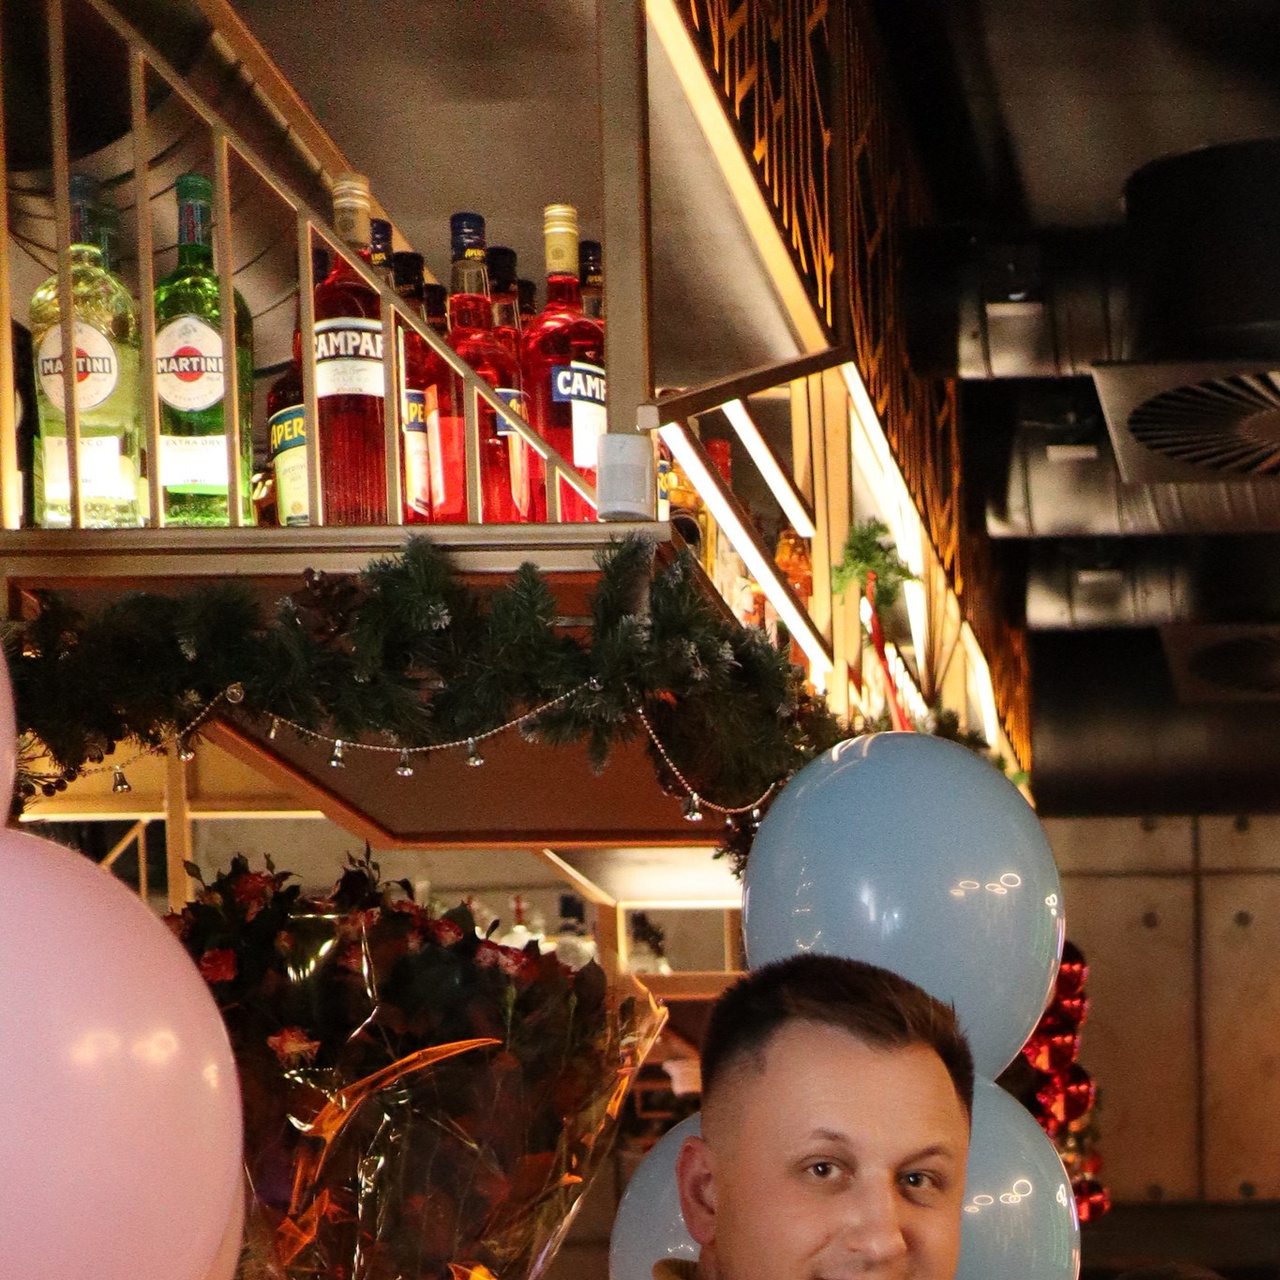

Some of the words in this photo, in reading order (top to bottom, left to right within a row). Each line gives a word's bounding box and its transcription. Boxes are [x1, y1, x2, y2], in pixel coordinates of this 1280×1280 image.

[315, 330, 383, 360] AMPA
[43, 358, 110, 374] MATINI
[157, 357, 224, 374] MARTINI
[271, 416, 306, 454] APER
